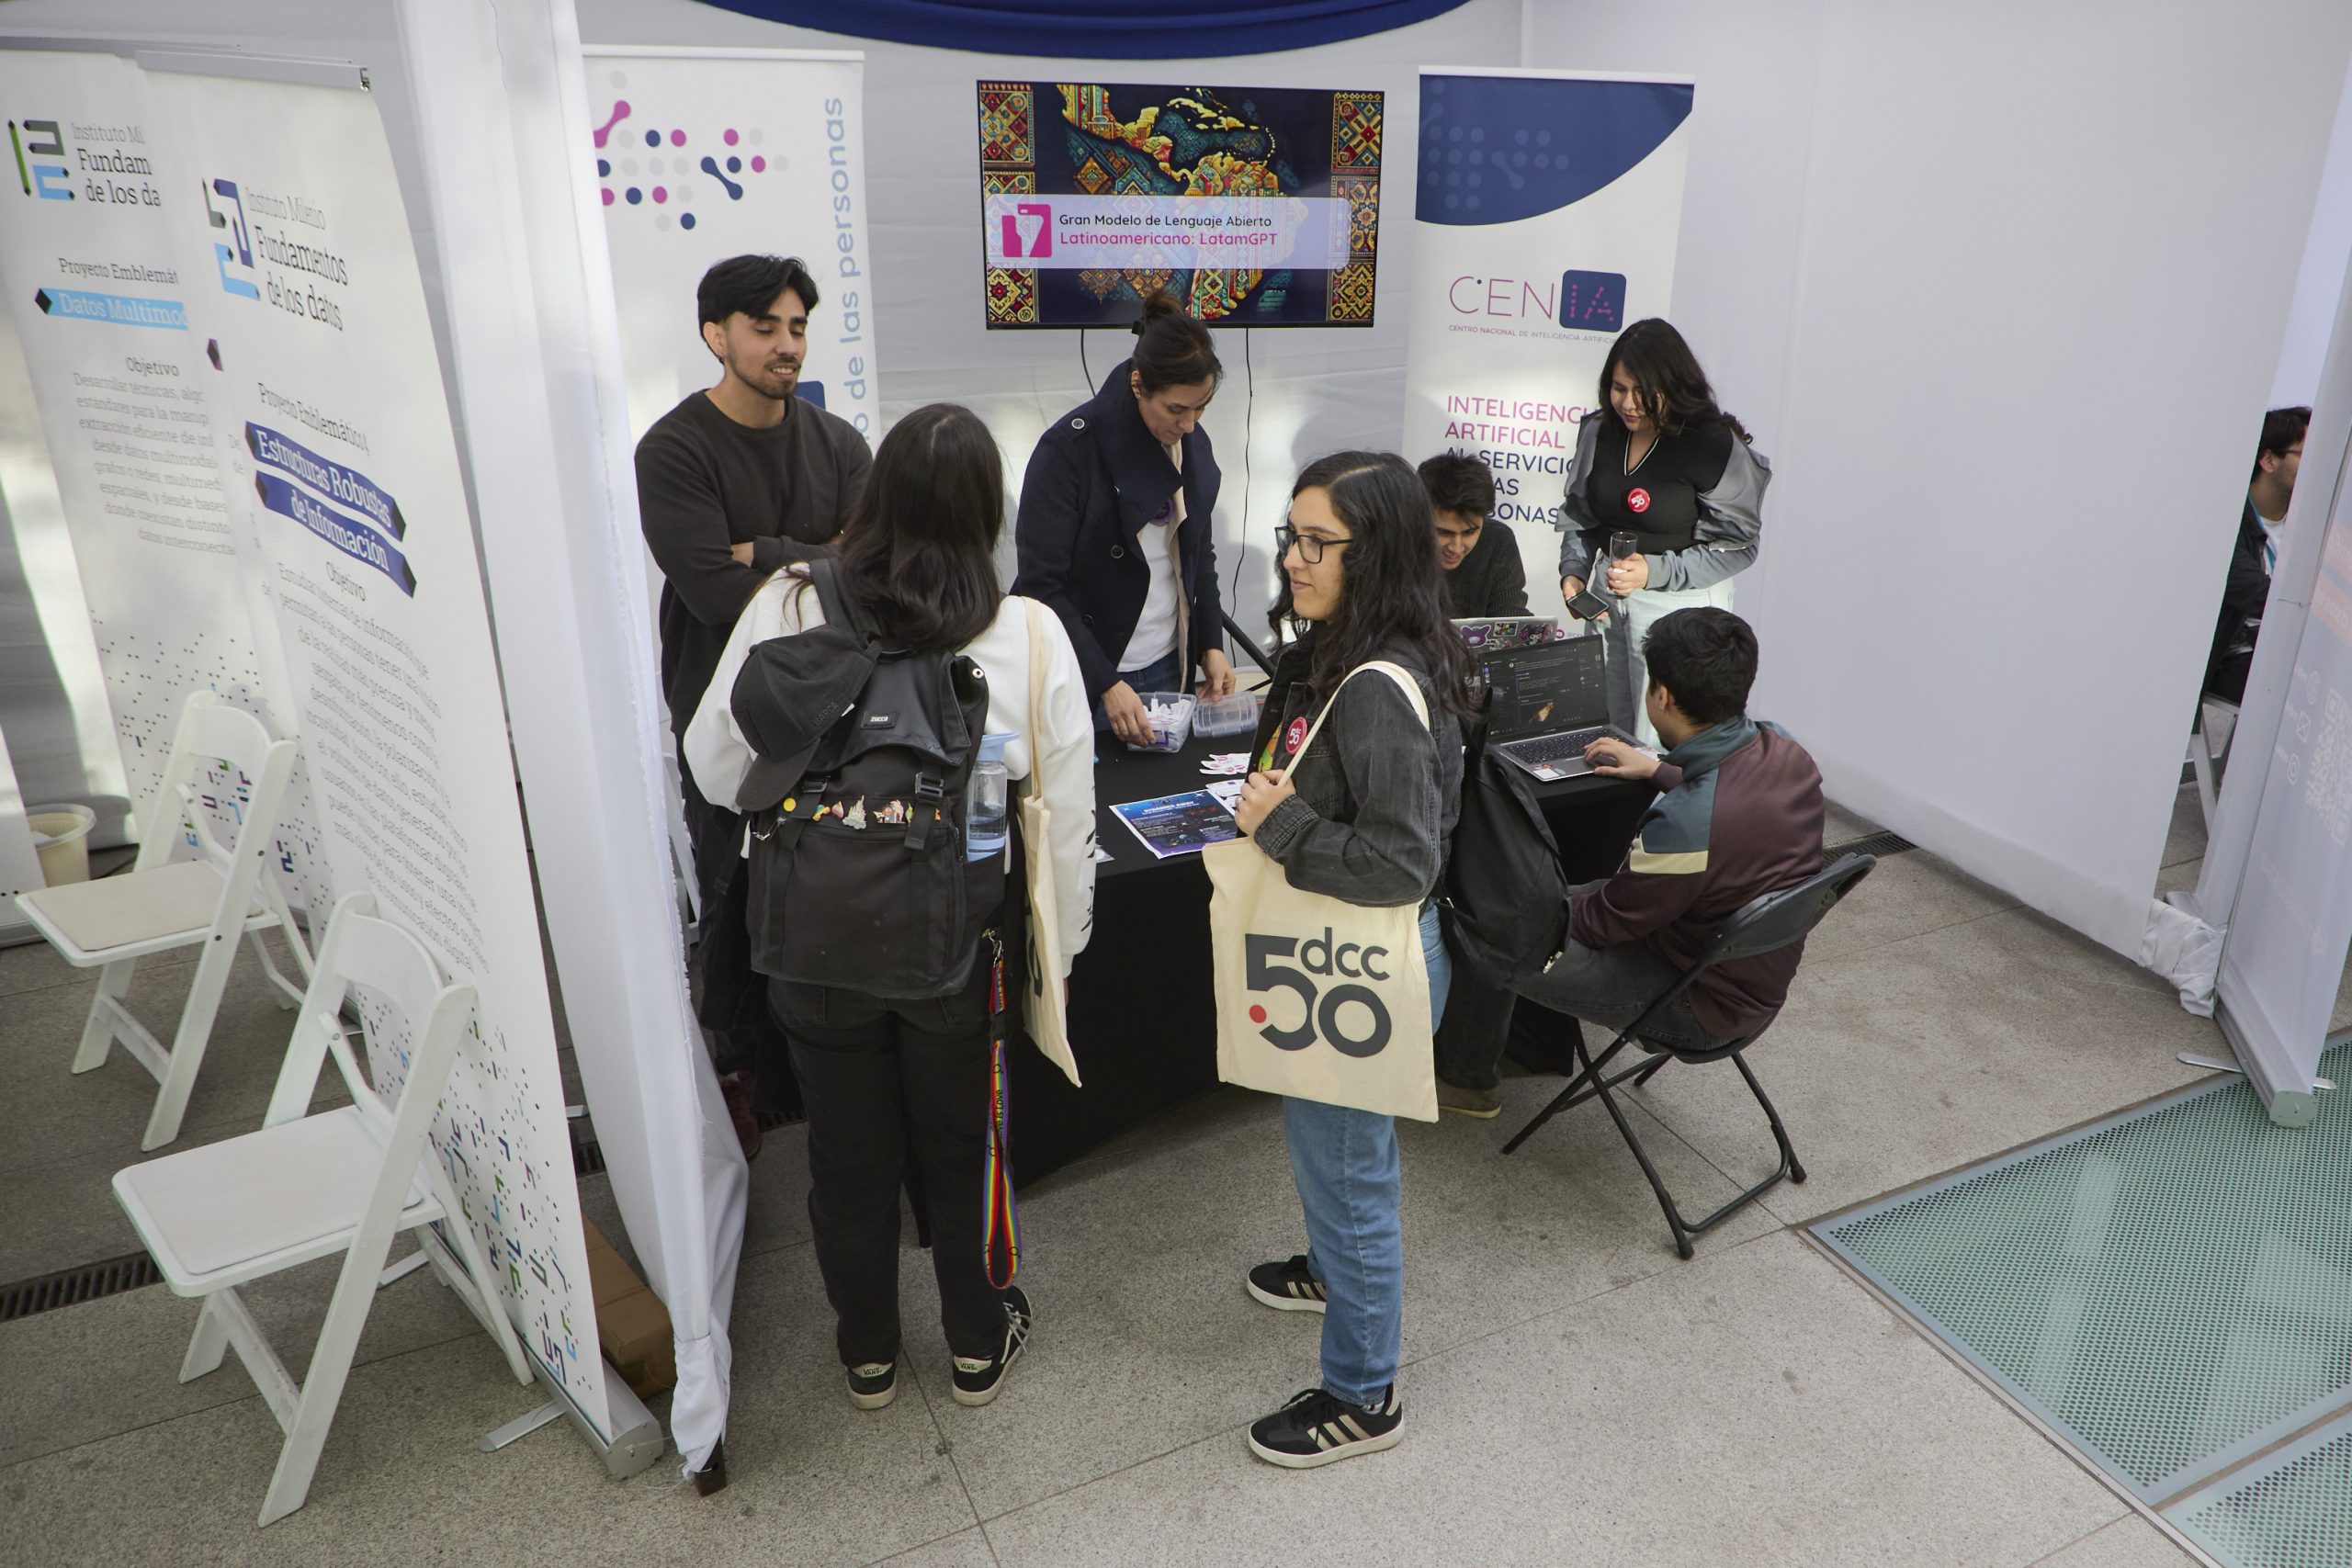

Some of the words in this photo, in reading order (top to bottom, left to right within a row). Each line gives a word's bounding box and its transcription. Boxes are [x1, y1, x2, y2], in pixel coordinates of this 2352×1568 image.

[71, 122, 127, 142] Instituto
[76, 148, 153, 175] Fundam
[85, 178, 105, 203] de
[107, 180, 138, 205] los
[824, 97, 862, 278] personas
[1059, 214, 1091, 226] Gran
[1094, 215, 1141, 226] Modelo
[1145, 215, 1161, 226] de
[1165, 216, 1223, 229] Lenguaje
[1226, 216, 1272, 227] Abierto
[1060, 231, 1194, 245] Latinoamericano:
[1200, 232, 1278, 245] LatamGPT
[58, 257, 110, 278] Proyecto
[254, 225, 348, 287] Fundamentos
[58, 293, 107, 318] Datos
[267, 271, 283, 309] de
[279, 276, 305, 316] los
[307, 284, 343, 332] datos
[840, 289, 863, 344] las
[1449, 324, 1478, 333] CENTRO
[1480, 326, 1516, 336] NACIONAL
[1519, 330, 1529, 338] DE
[1531, 331, 1580, 342] INTELIGENCIA
[1582, 334, 1617, 344] ARTIFICIA
[126, 356, 180, 378] Objetivo
[843, 356, 866, 400] de
[1447, 395, 1595, 425] INTELIGENC
[1444, 421, 1566, 449] ARTIFICIAL
[256, 429, 332, 492] Estructuras
[328, 466, 392, 528] Robustas
[1494, 477, 1520, 496] AS
[291, 490, 308, 523] de
[304, 498, 390, 572] Información
[325, 561, 366, 602] Objetivo
[1300, 926, 1391, 982] dcc
[1244, 933, 1393, 1058] 50
